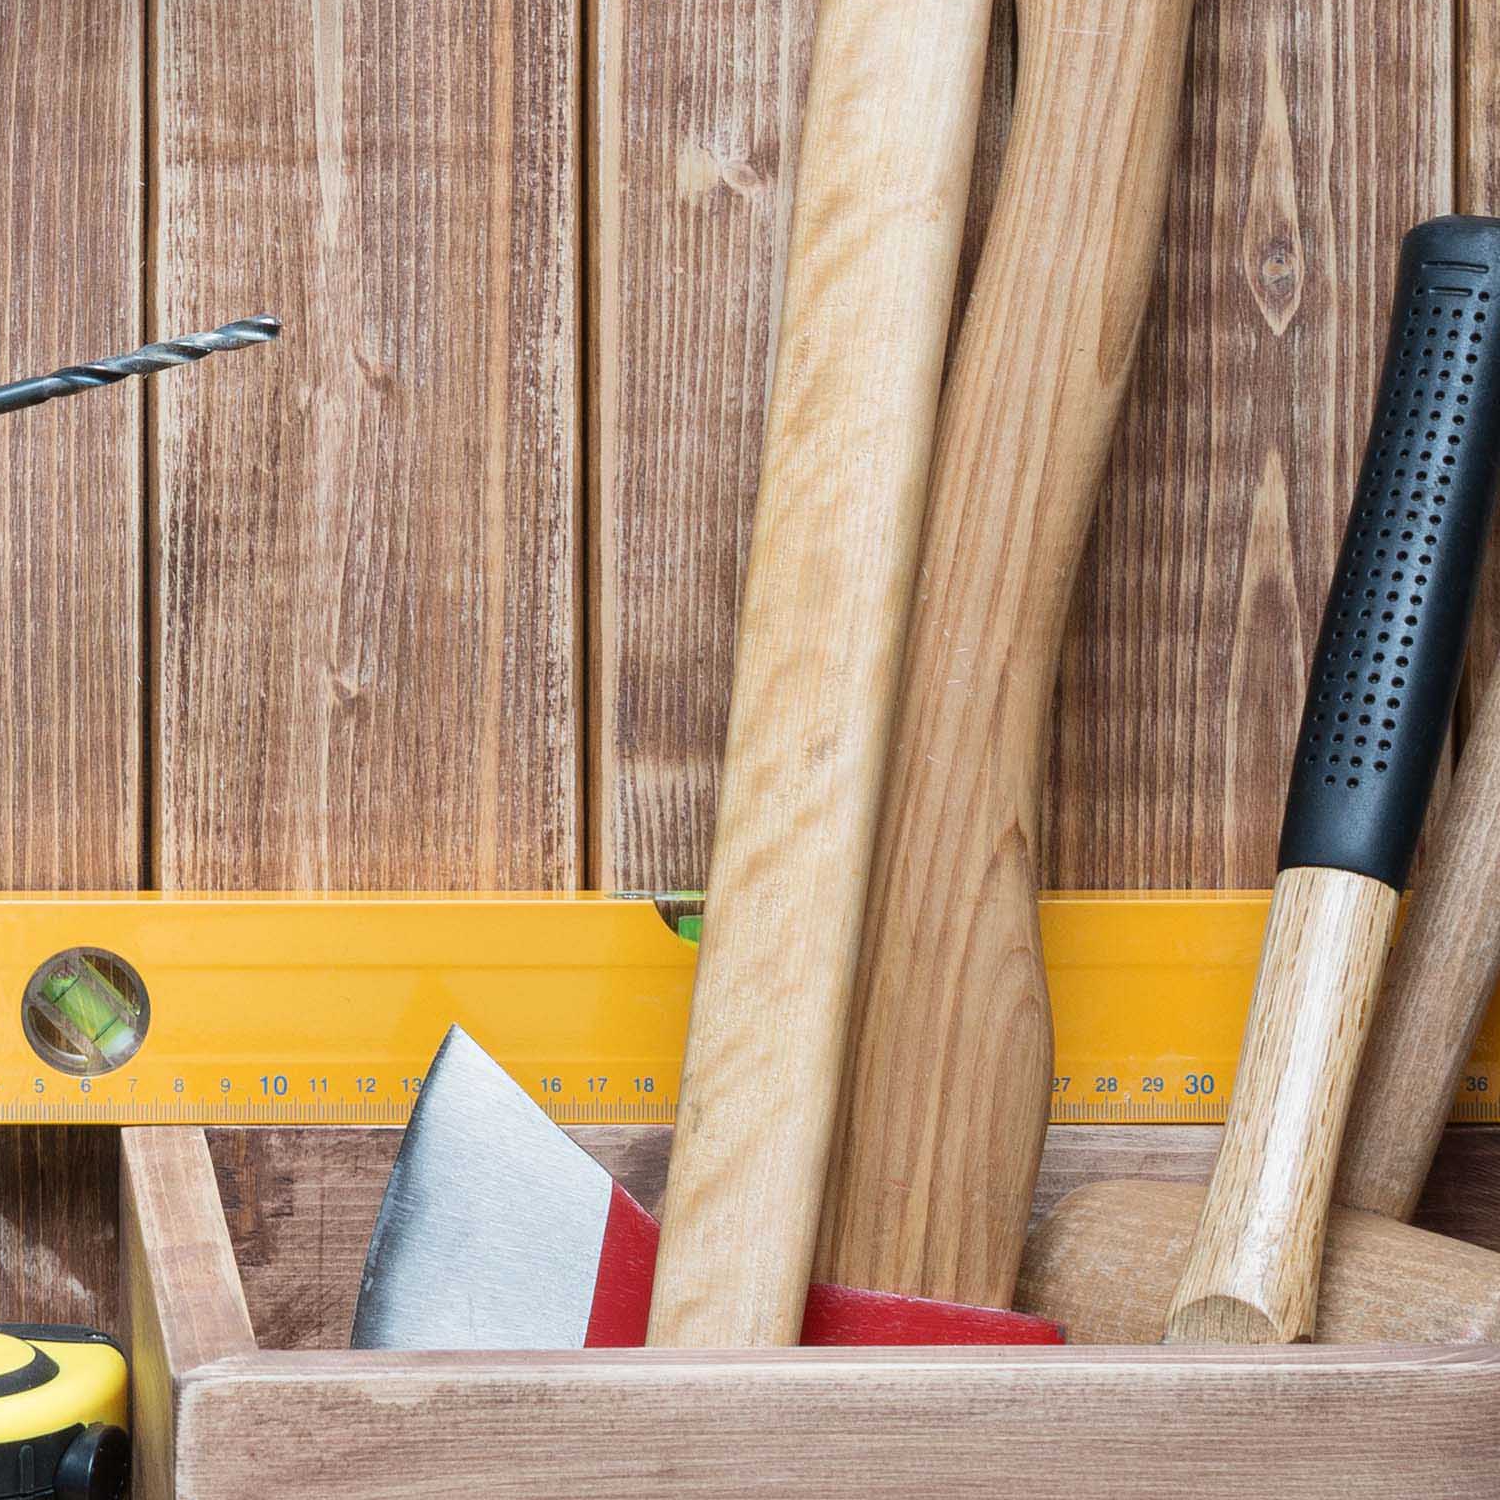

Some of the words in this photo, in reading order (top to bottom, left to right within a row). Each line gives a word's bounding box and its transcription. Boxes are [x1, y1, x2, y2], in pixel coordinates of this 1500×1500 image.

[34, 1077, 45, 1094] 5
[80, 1077, 92, 1094] 6
[127, 1077, 138, 1094] 7
[173, 1077, 185, 1094] 8
[220, 1077, 232, 1094] 9
[259, 1075, 288, 1096] 10
[309, 1077, 328, 1093] 11
[355, 1077, 377, 1093] 12
[540, 1077, 562, 1093] 16
[587, 1077, 608, 1093] 17
[634, 1077, 655, 1093] 18
[1051, 1076, 1071, 1093] 27
[1095, 1076, 1118, 1093] 28
[1141, 1076, 1164, 1093] 29
[1184, 1074, 1215, 1095] 30
[1466, 1075, 1489, 1093] 36
